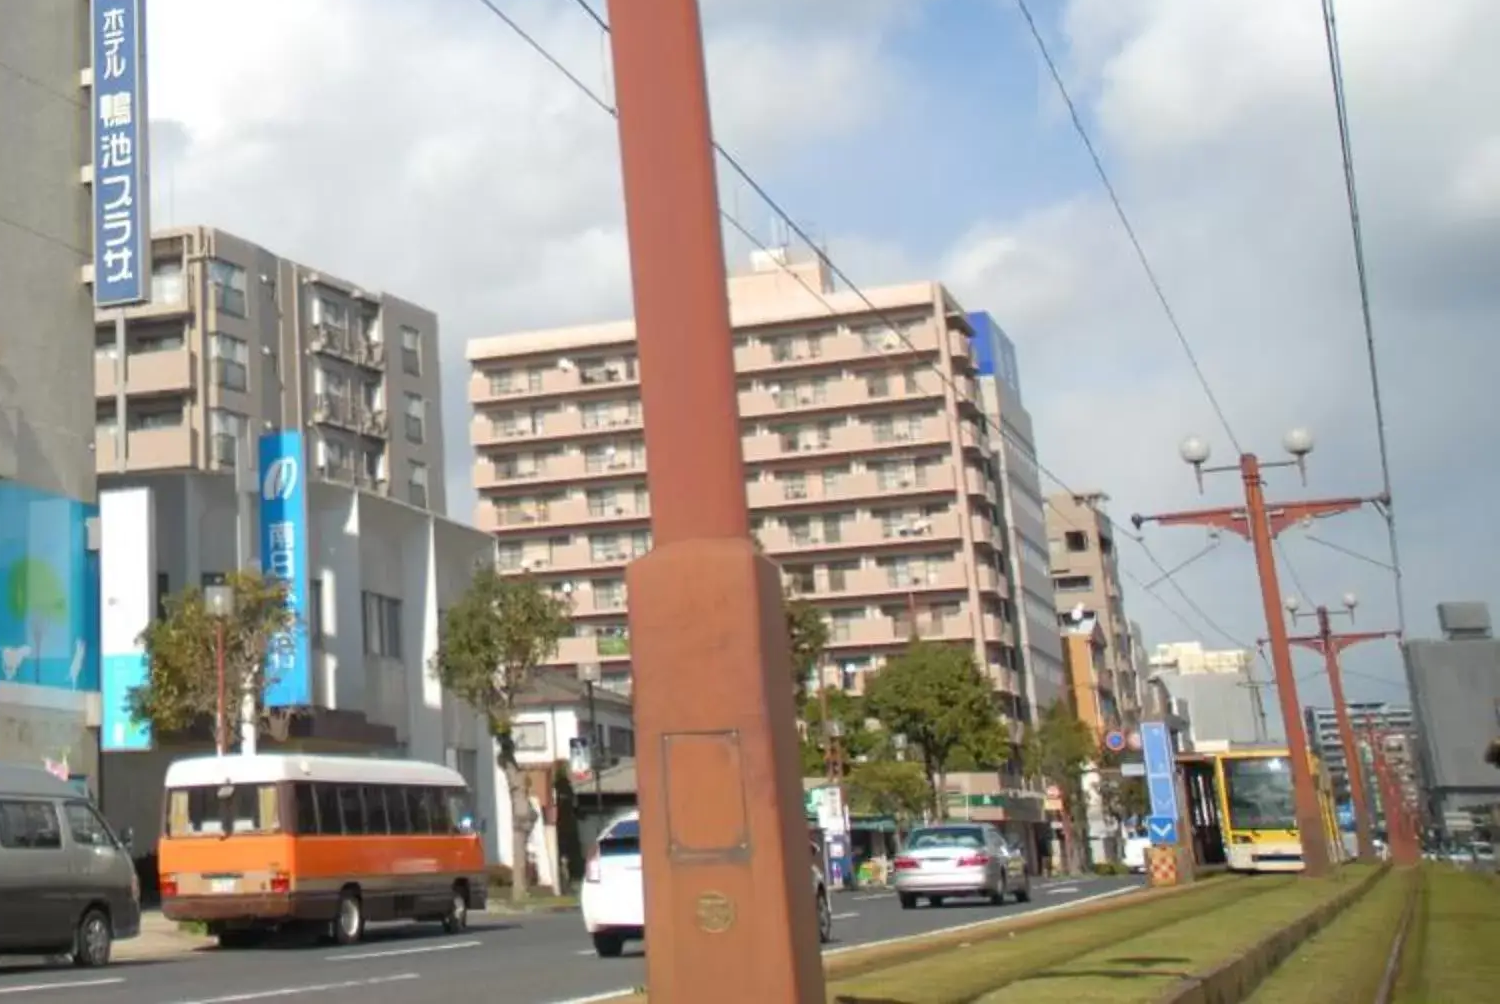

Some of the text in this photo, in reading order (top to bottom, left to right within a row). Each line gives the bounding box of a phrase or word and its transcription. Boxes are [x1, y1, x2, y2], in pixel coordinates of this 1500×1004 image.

[100, 8, 133, 283] ホテル 鴨池プラザ
